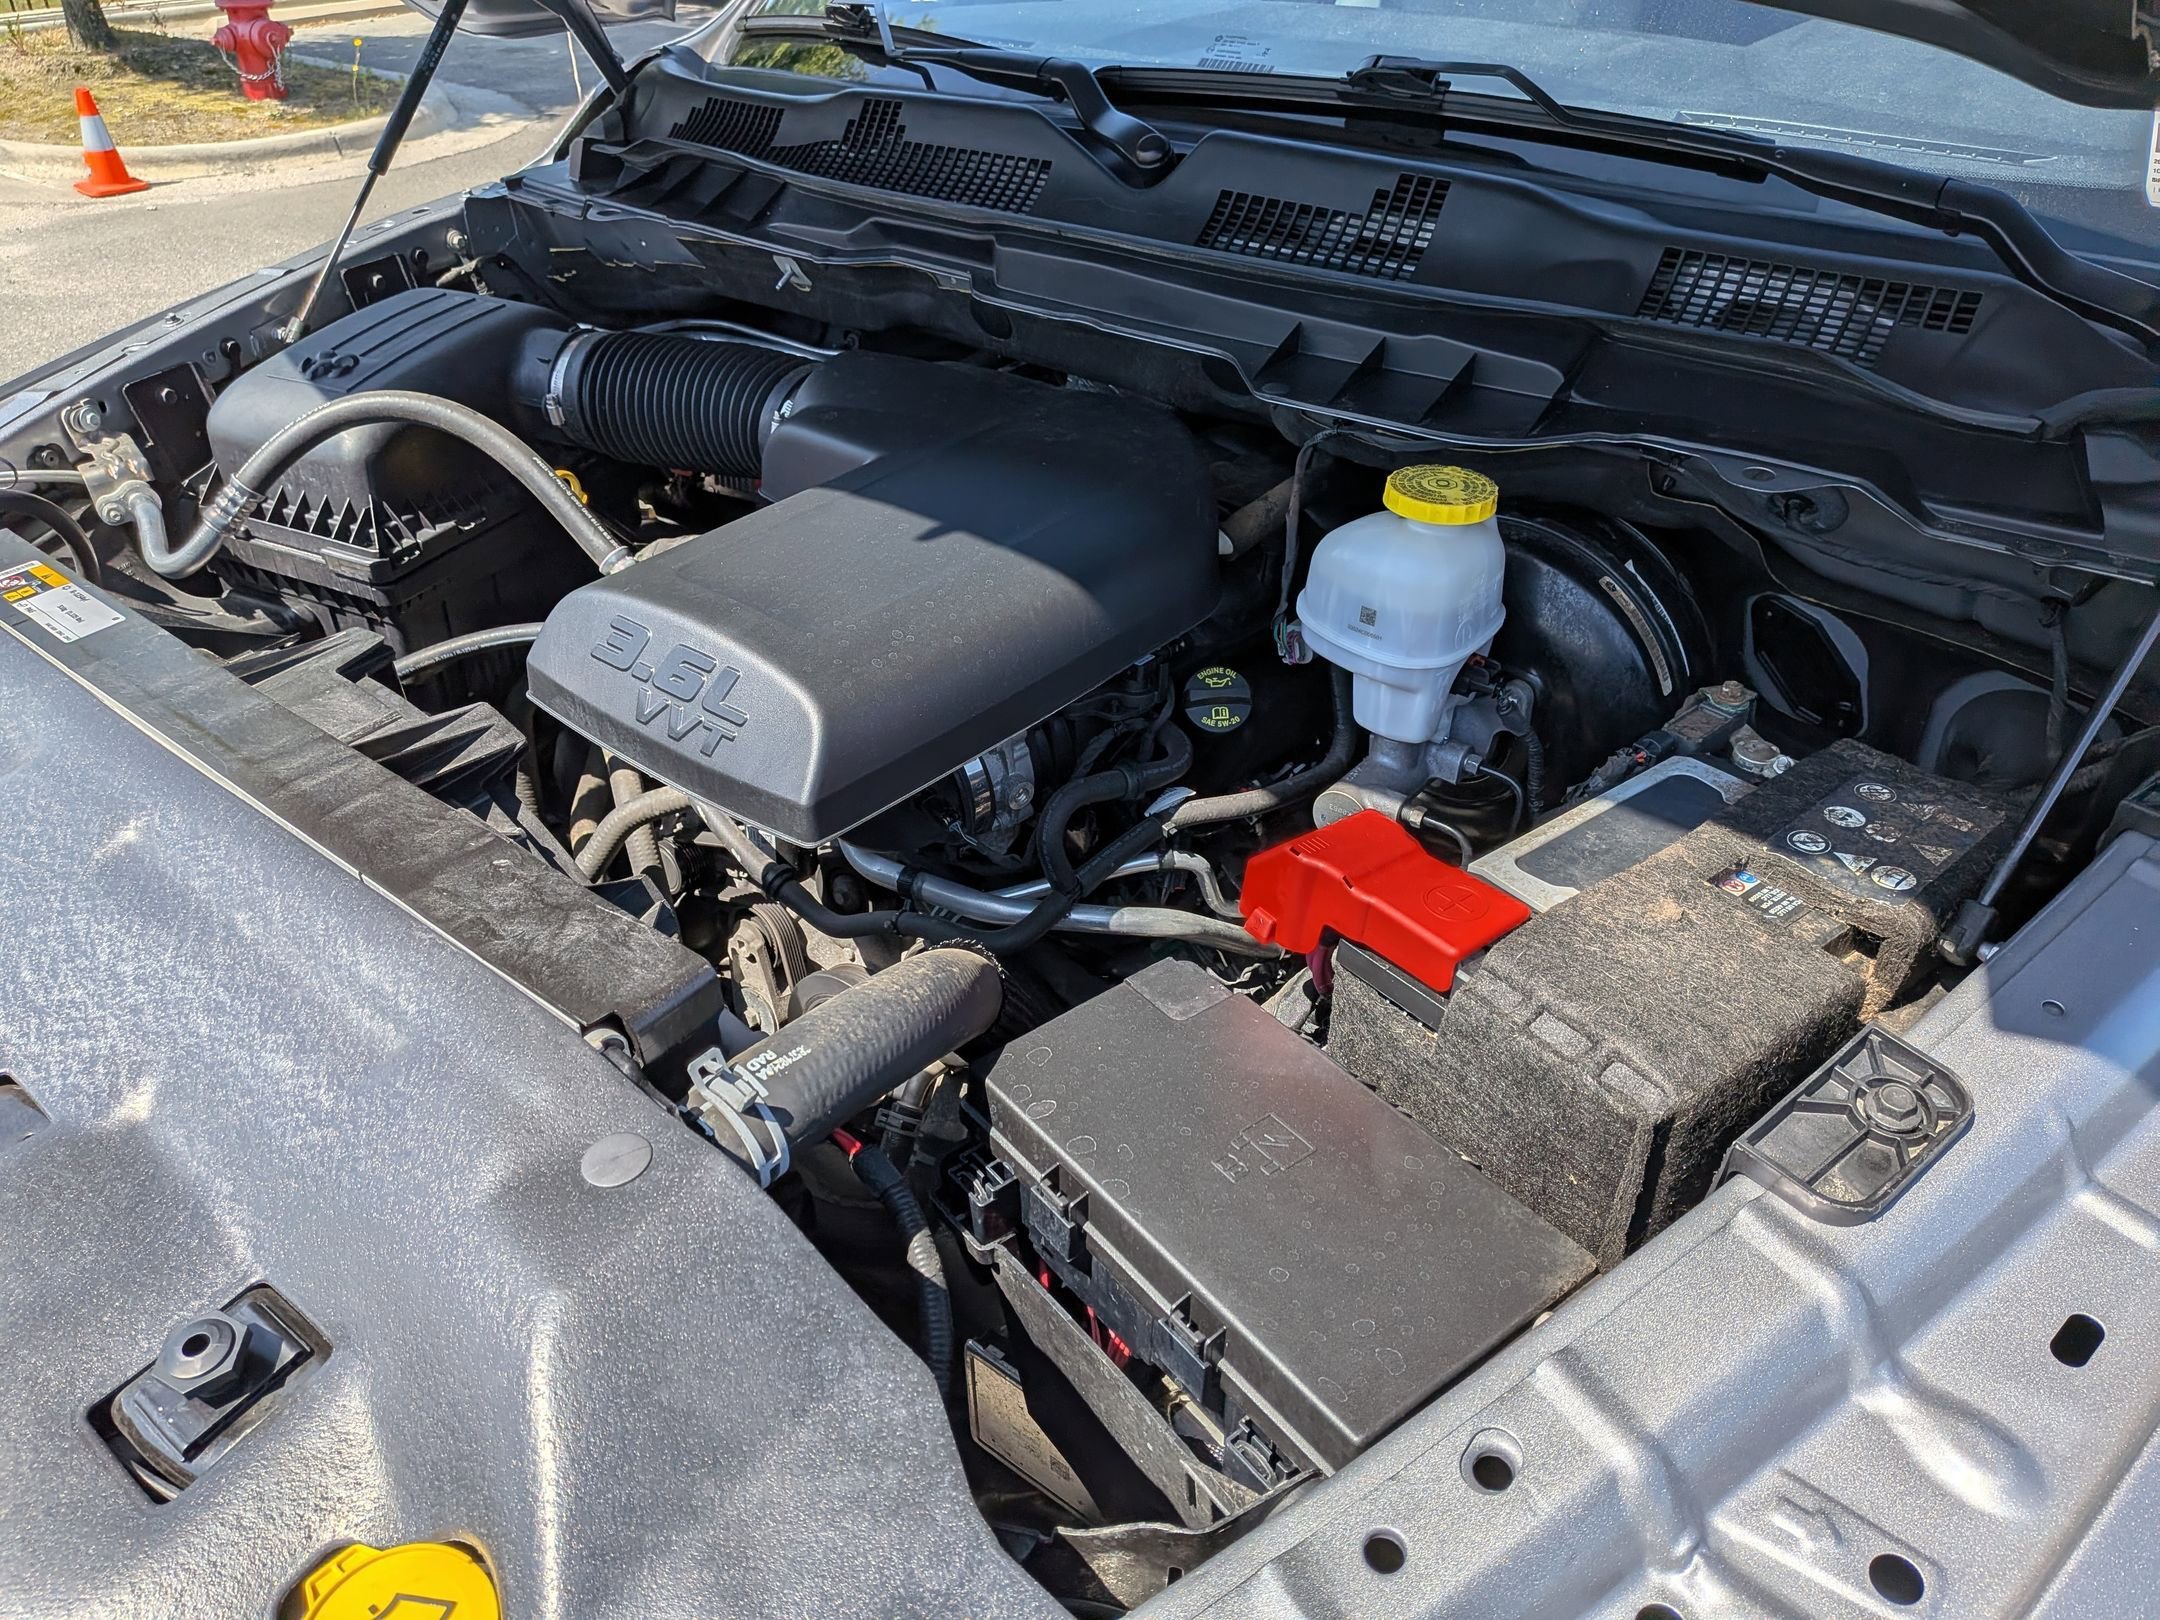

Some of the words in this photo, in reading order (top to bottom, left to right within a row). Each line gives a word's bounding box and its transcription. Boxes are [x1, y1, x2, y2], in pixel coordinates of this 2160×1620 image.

[590, 614, 749, 727] 3.6L
[1197, 666, 1224, 680] ENGINE
[1225, 668, 1238, 679] OIL
[635, 687, 738, 757] VVT
[1201, 716, 1216, 727] SAE
[1217, 715, 1241, 727] 5W-20
[746, 1049, 777, 1071] RAD
